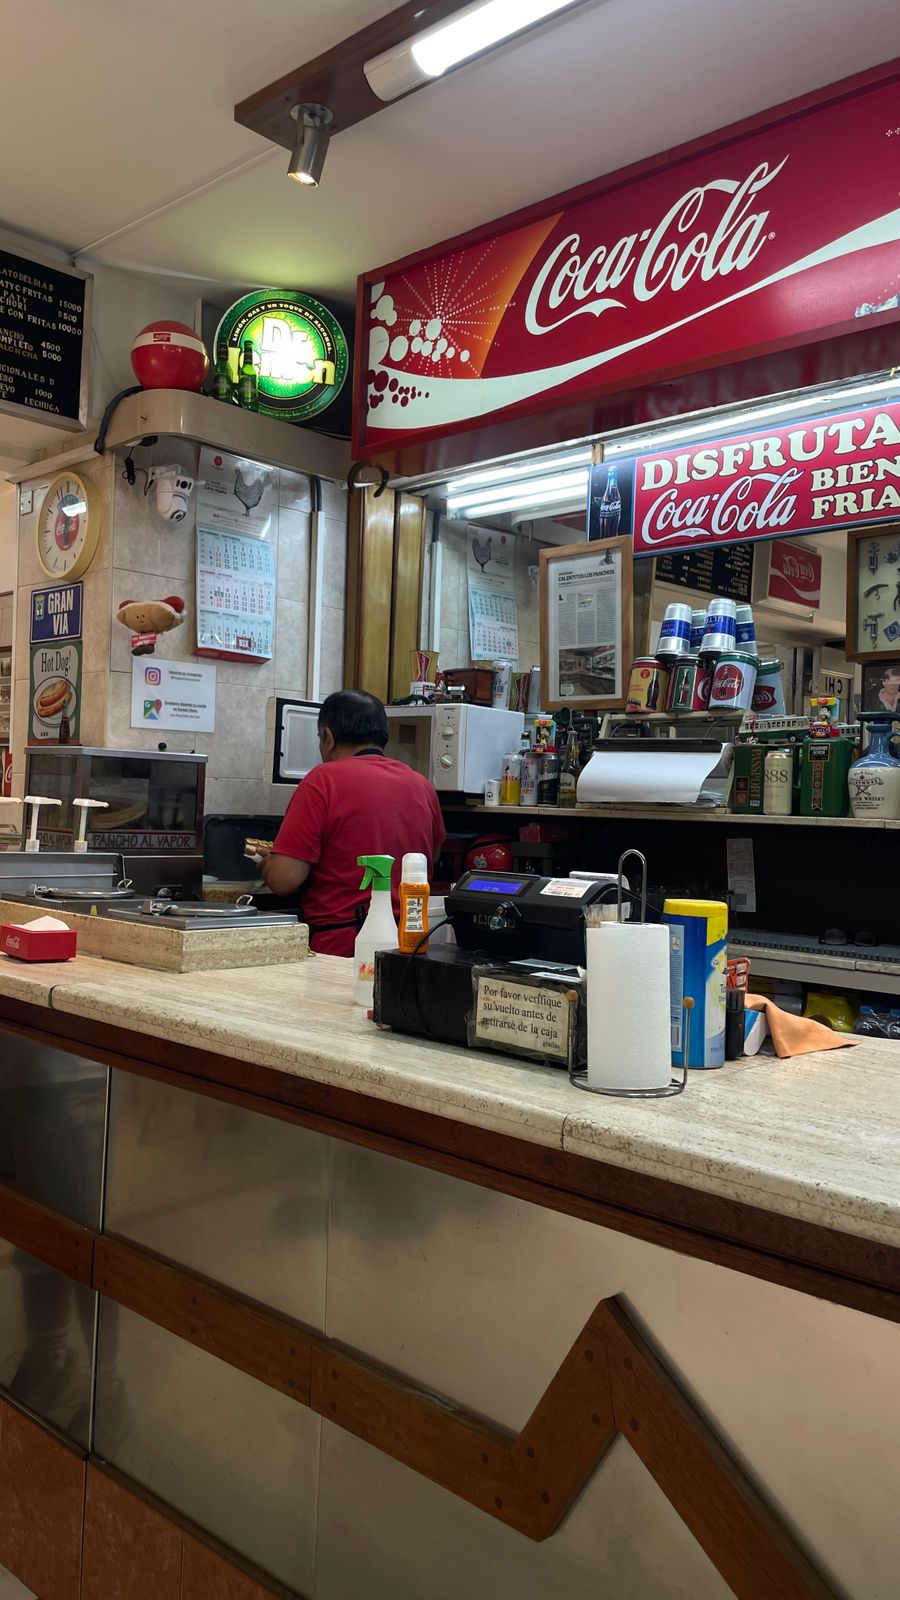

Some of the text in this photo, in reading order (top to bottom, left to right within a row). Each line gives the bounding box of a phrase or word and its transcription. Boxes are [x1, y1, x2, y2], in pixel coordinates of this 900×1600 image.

[525, 153, 790, 336] Coca-Cola
[7, 308, 24, 319] CON
[27, 314, 57, 330] FRITAS
[279, 303, 304, 314] TOQUE
[41, 341, 61, 353] 4500
[641, 412, 900, 491] DISFRUTA
[641, 466, 805, 545] Coca-Cola
[47, 589, 74, 614] GRAN
[53, 614, 69, 635] VIA
[41, 651, 72, 677] Hot Dog!
[92, 834, 190, 848] PANCHO AL VAPOR
[484, 985, 499, 997] Por
[500, 987, 521, 1001] favor
[483, 1001, 557, 1023] su vuelto antes de
[482, 1016, 558, 1039] retirarse de la caja
